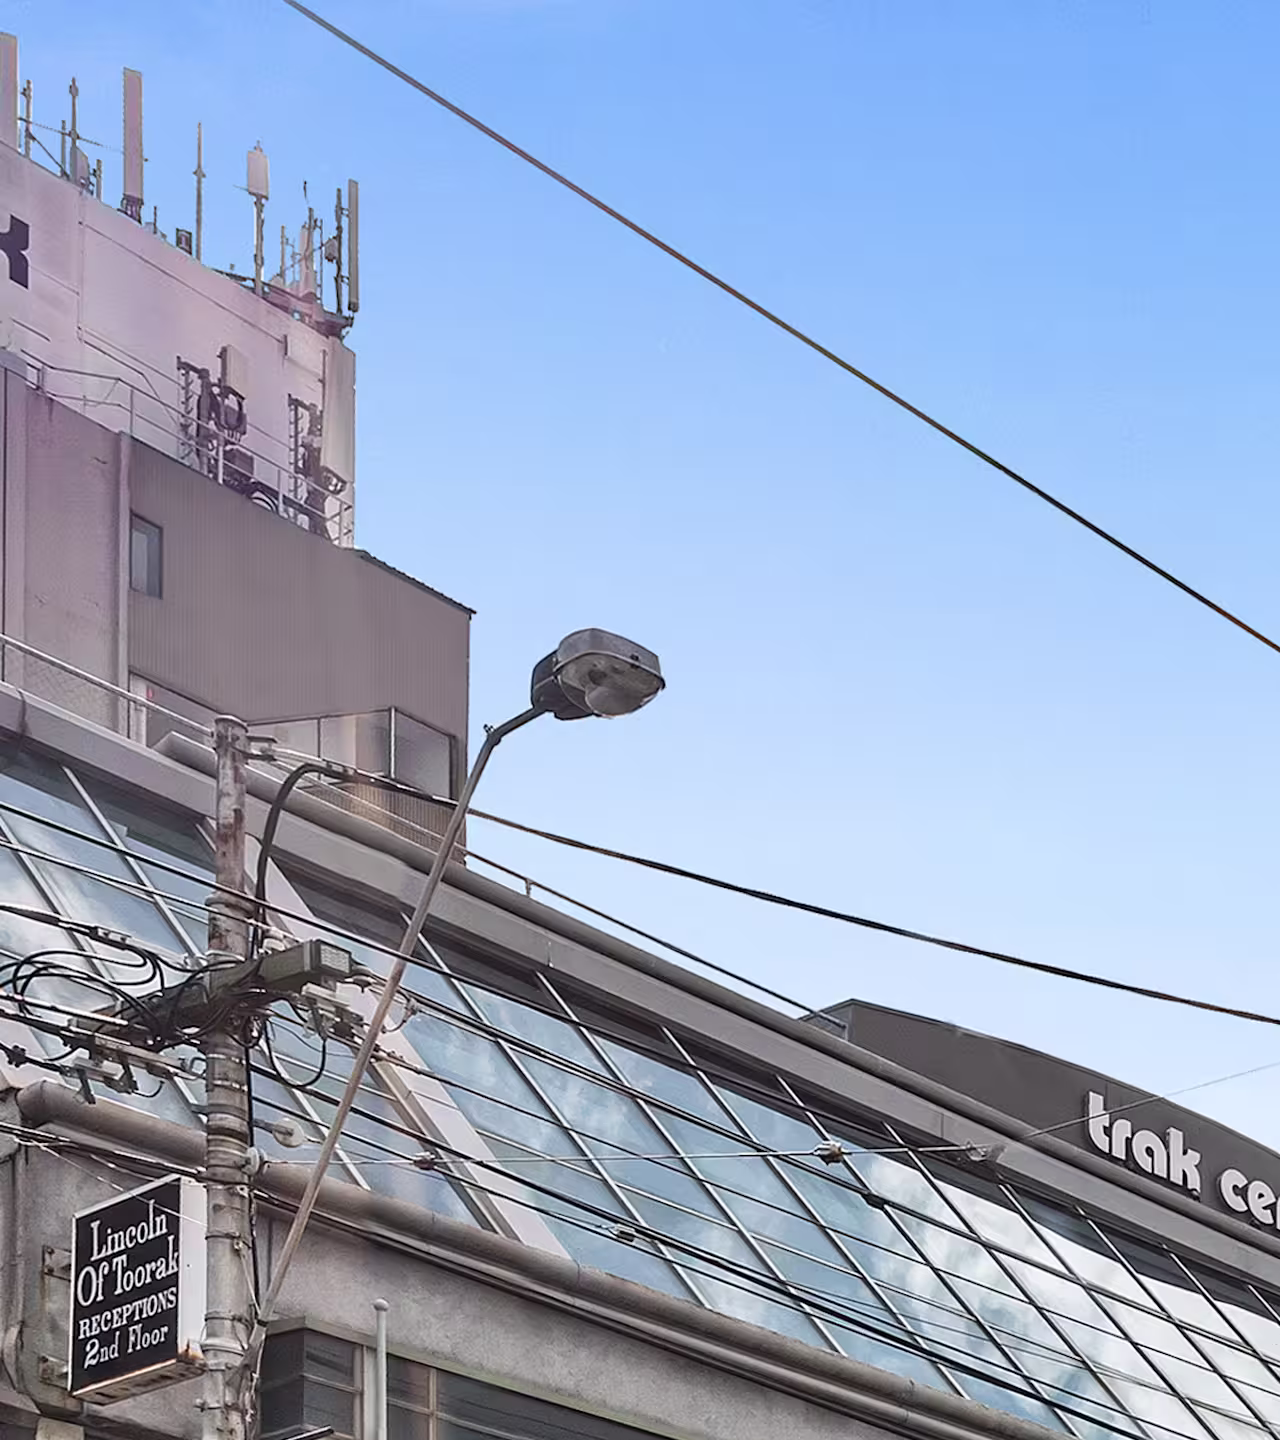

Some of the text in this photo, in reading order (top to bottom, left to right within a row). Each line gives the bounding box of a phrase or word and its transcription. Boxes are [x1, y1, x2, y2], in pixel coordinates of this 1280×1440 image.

[1086, 1090, 1201, 1192] trak
[90, 1198, 168, 1262] Lincoln
[76, 1235, 179, 1307] Of Toorak
[78, 1287, 177, 1340] RECEPTIONS
[84, 1323, 169, 1369] 2nd Floor
